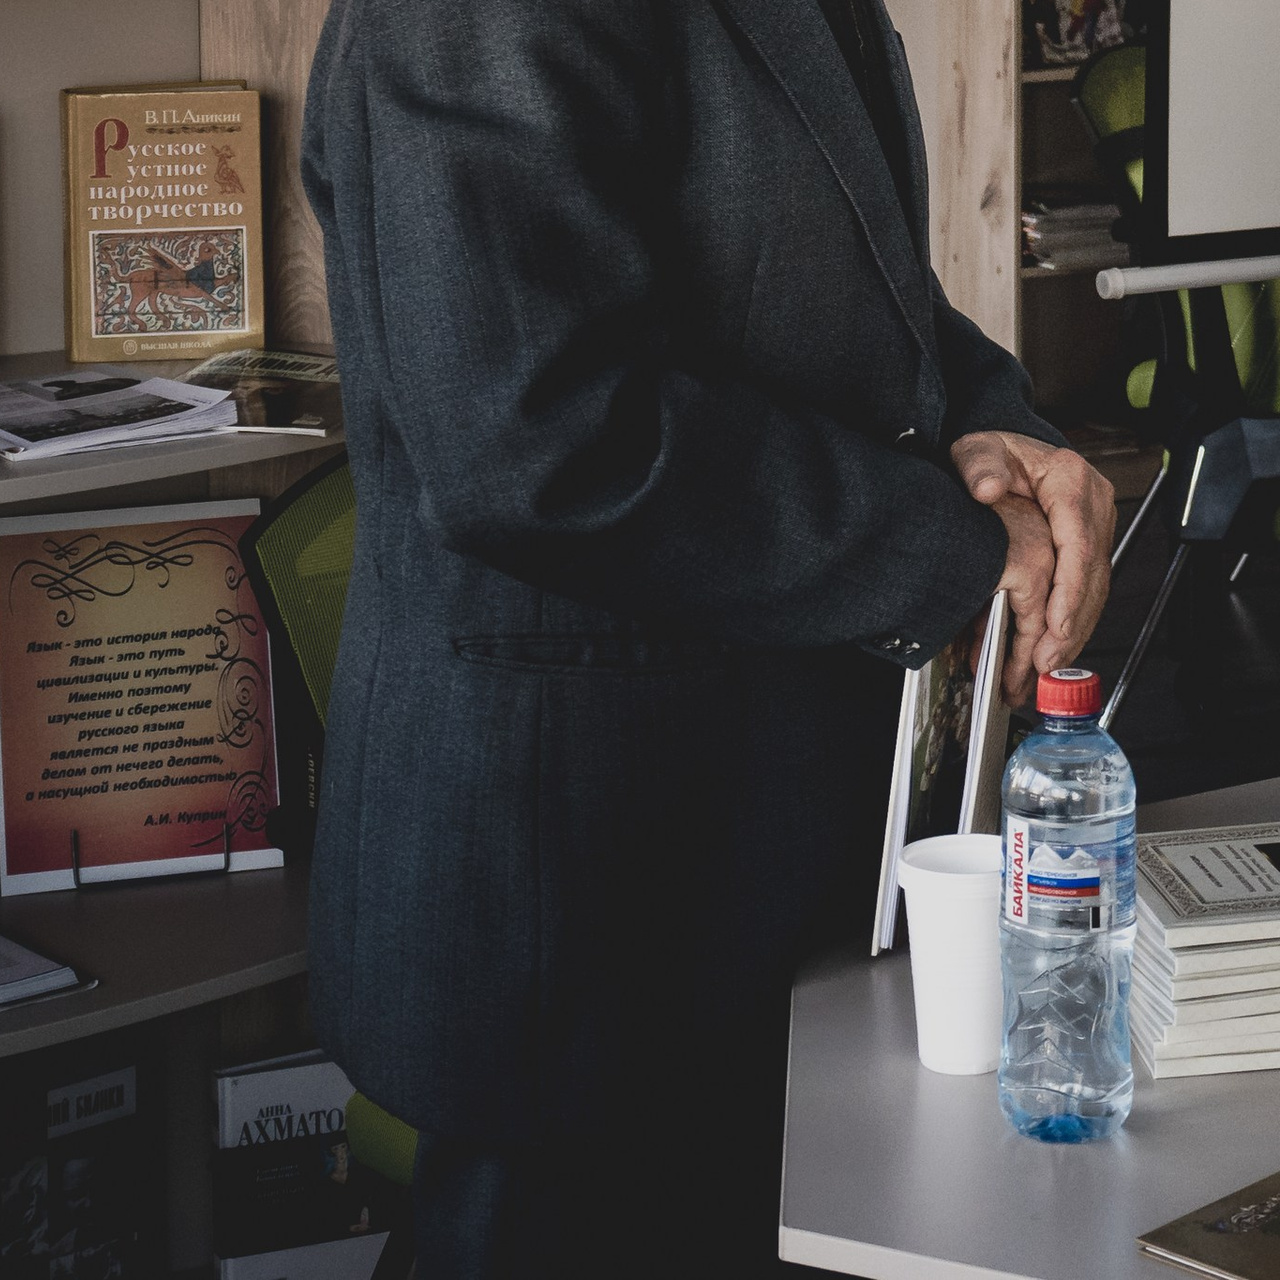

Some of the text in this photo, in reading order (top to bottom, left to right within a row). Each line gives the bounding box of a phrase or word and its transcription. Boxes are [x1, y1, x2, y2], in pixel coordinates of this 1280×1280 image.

[181, 110, 242, 124] Аникин
[90, 117, 207, 179] Русское
[127, 162, 208, 183] устное
[90, 183, 209, 205] народное
[87, 201, 244, 225] творчество
[26, 641, 62, 654] Язык
[73, 636, 102, 649] это
[106, 630, 168, 648] история
[69, 646, 186, 667] Язык это путь
[36, 661, 219, 690] цивилизации и культуры.
[67, 682, 192, 703] Именно поэтому
[47, 699, 212, 725] изучение и сбережение
[77, 720, 185, 742] русского языка
[50, 736, 214, 761] является не праздным
[41, 752, 224, 781] делом от нечего делать,
[24, 791, 34, 801] а
[38, 781, 109, 800] насущной
[143, 810, 228, 826] А.И. Куприн
[257, 1103, 292, 1119] АННА
[238, 1107, 345, 1148] АХМАТО
